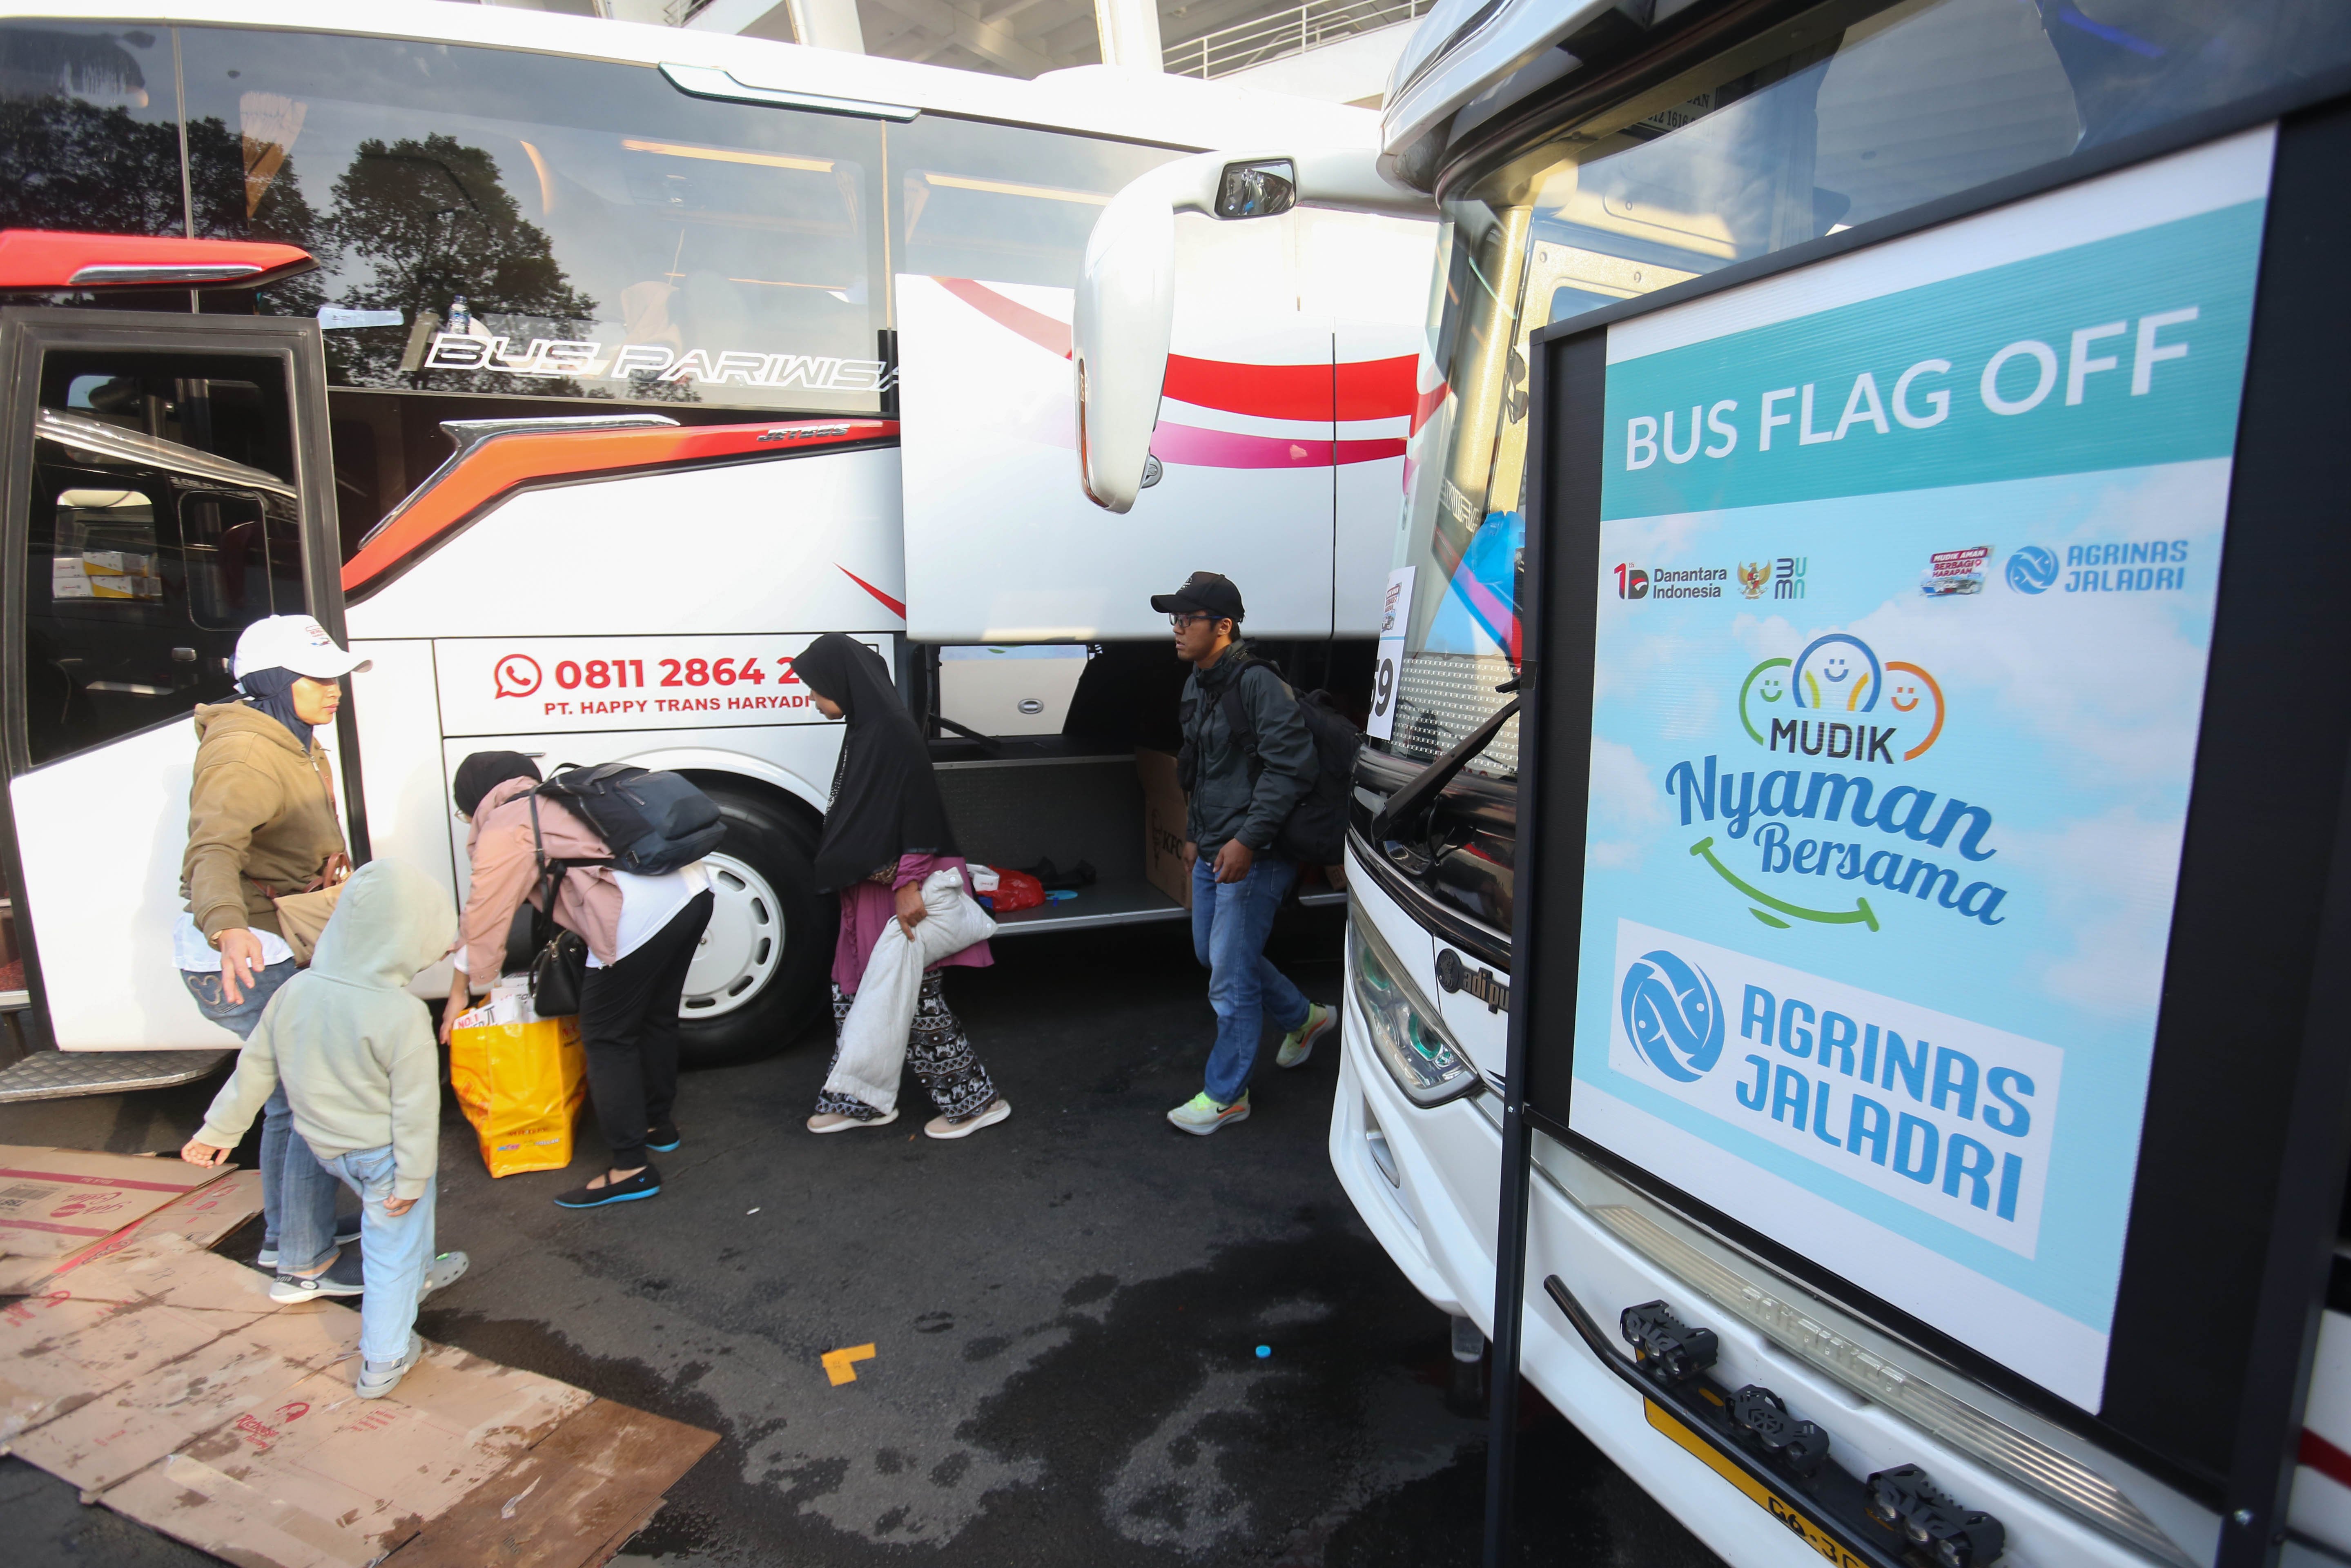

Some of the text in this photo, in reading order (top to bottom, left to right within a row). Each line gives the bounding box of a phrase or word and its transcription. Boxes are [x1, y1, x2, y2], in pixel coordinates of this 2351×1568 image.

[425, 332, 602, 378] BUS
[1626, 306, 2199, 471] BUS FLAG OFF
[757, 424, 851, 441] JETBUS
[1933, 550, 1985, 562] MUDIK AMAN
[1933, 559, 1974, 571] BERBAGI
[2067, 539, 2189, 567] AGRINAS
[1654, 566, 1727, 583] Danantara
[1932, 568, 1972, 578] HARAPAN
[2064, 566, 2186, 592] JALADRI
[1653, 584, 1721, 599] Indonesia
[555, 659, 644, 689] 0811
[659, 658, 765, 687] 2864
[544, 702, 573, 715] PT.
[581, 700, 647, 714] HAPPY
[655, 698, 721, 711] TRANS
[1770, 717, 1896, 764] MUDIK
[1665, 755, 1997, 862] Nyaman
[1163, 829, 1183, 860] KFC
[1753, 822, 2008, 926] Bersama
[1463, 971, 1486, 1000] adi
[1740, 983, 2035, 1138] AGRINAS
[1736, 1054, 2023, 1223] JALADRI
